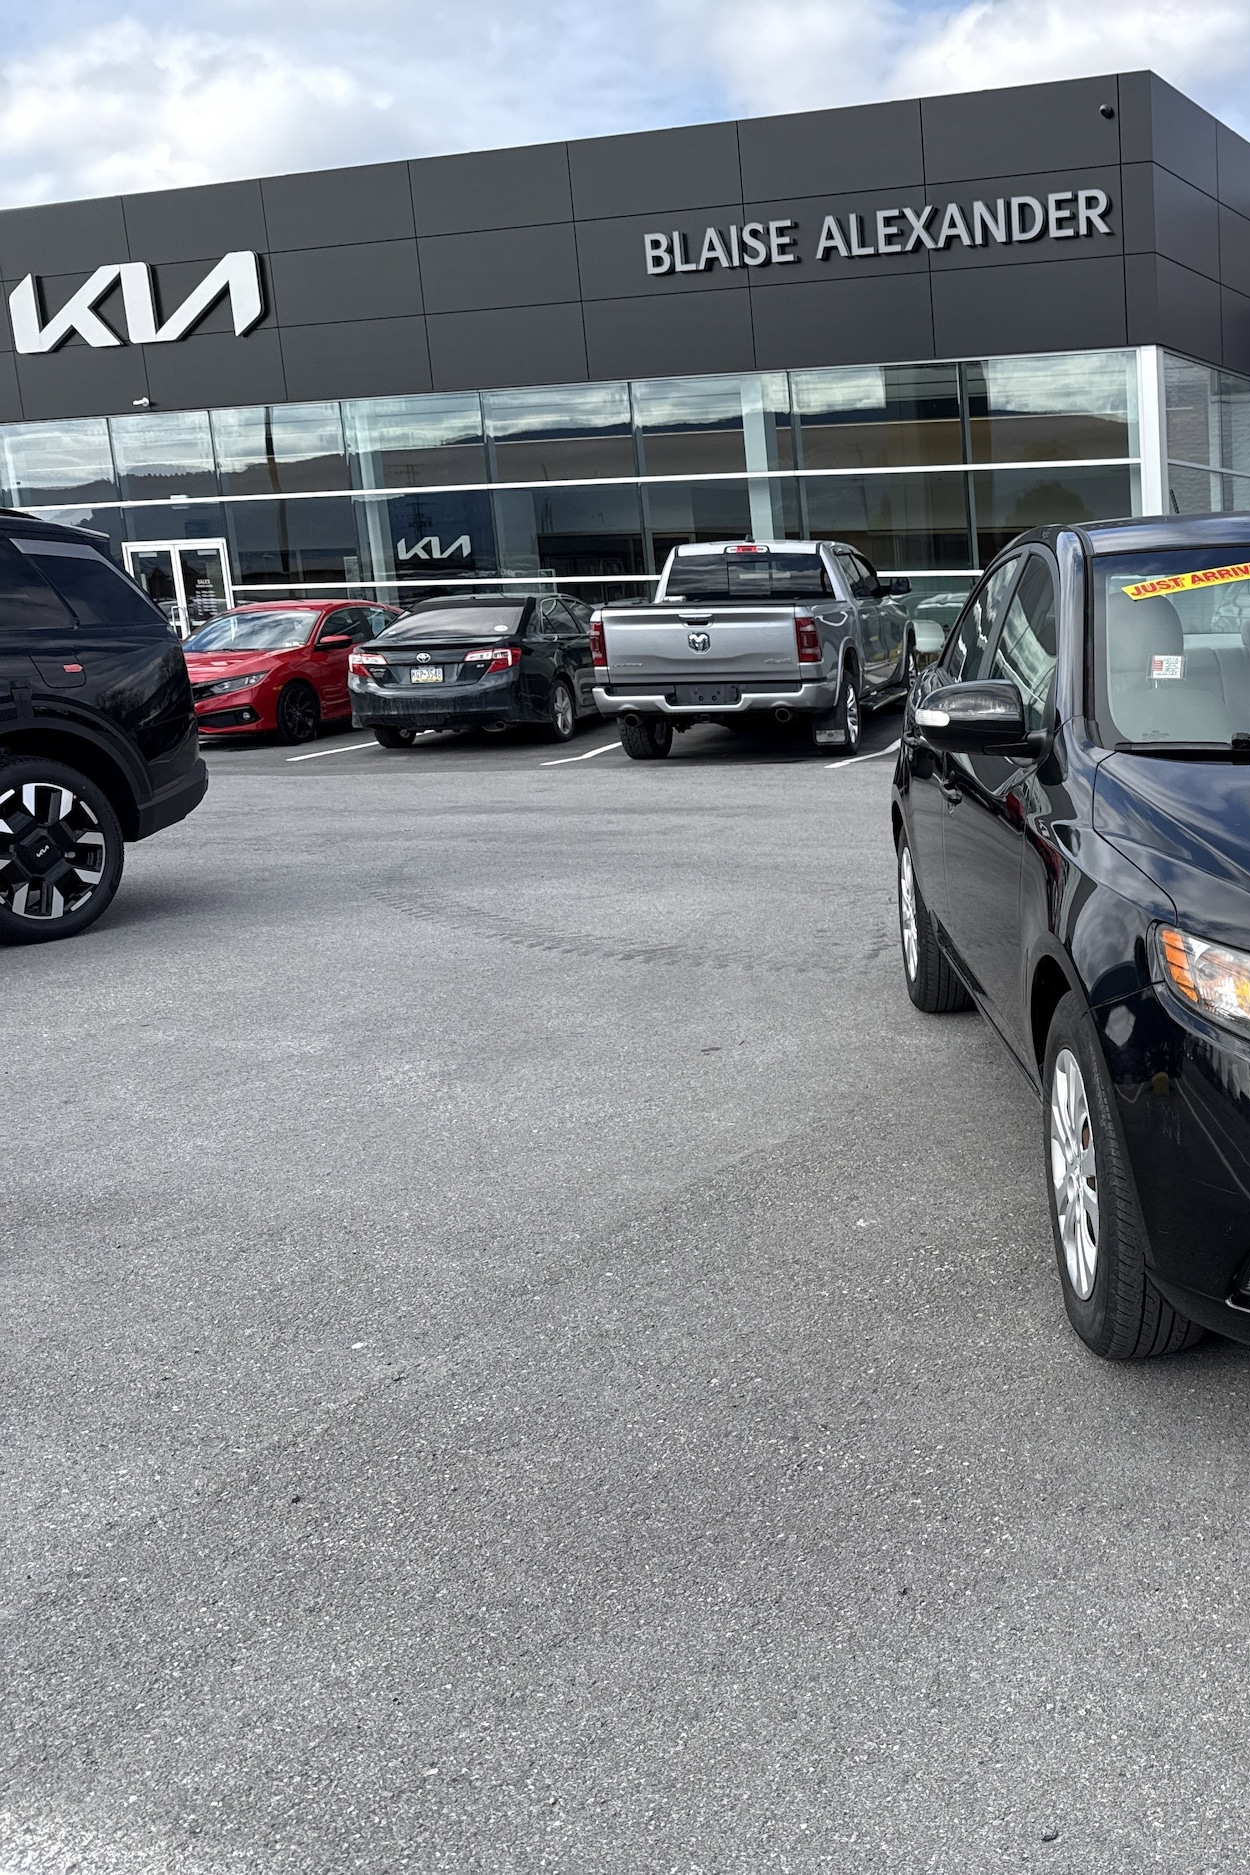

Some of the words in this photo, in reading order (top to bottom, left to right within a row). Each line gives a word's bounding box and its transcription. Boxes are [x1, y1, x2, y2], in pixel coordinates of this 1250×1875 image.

[643, 219, 798, 276] BLAISE
[815, 188, 1113, 260] ALEXANDER
[9, 250, 264, 354] KIA
[396, 534, 472, 560] KIA
[1131, 576, 1185, 597] JUST
